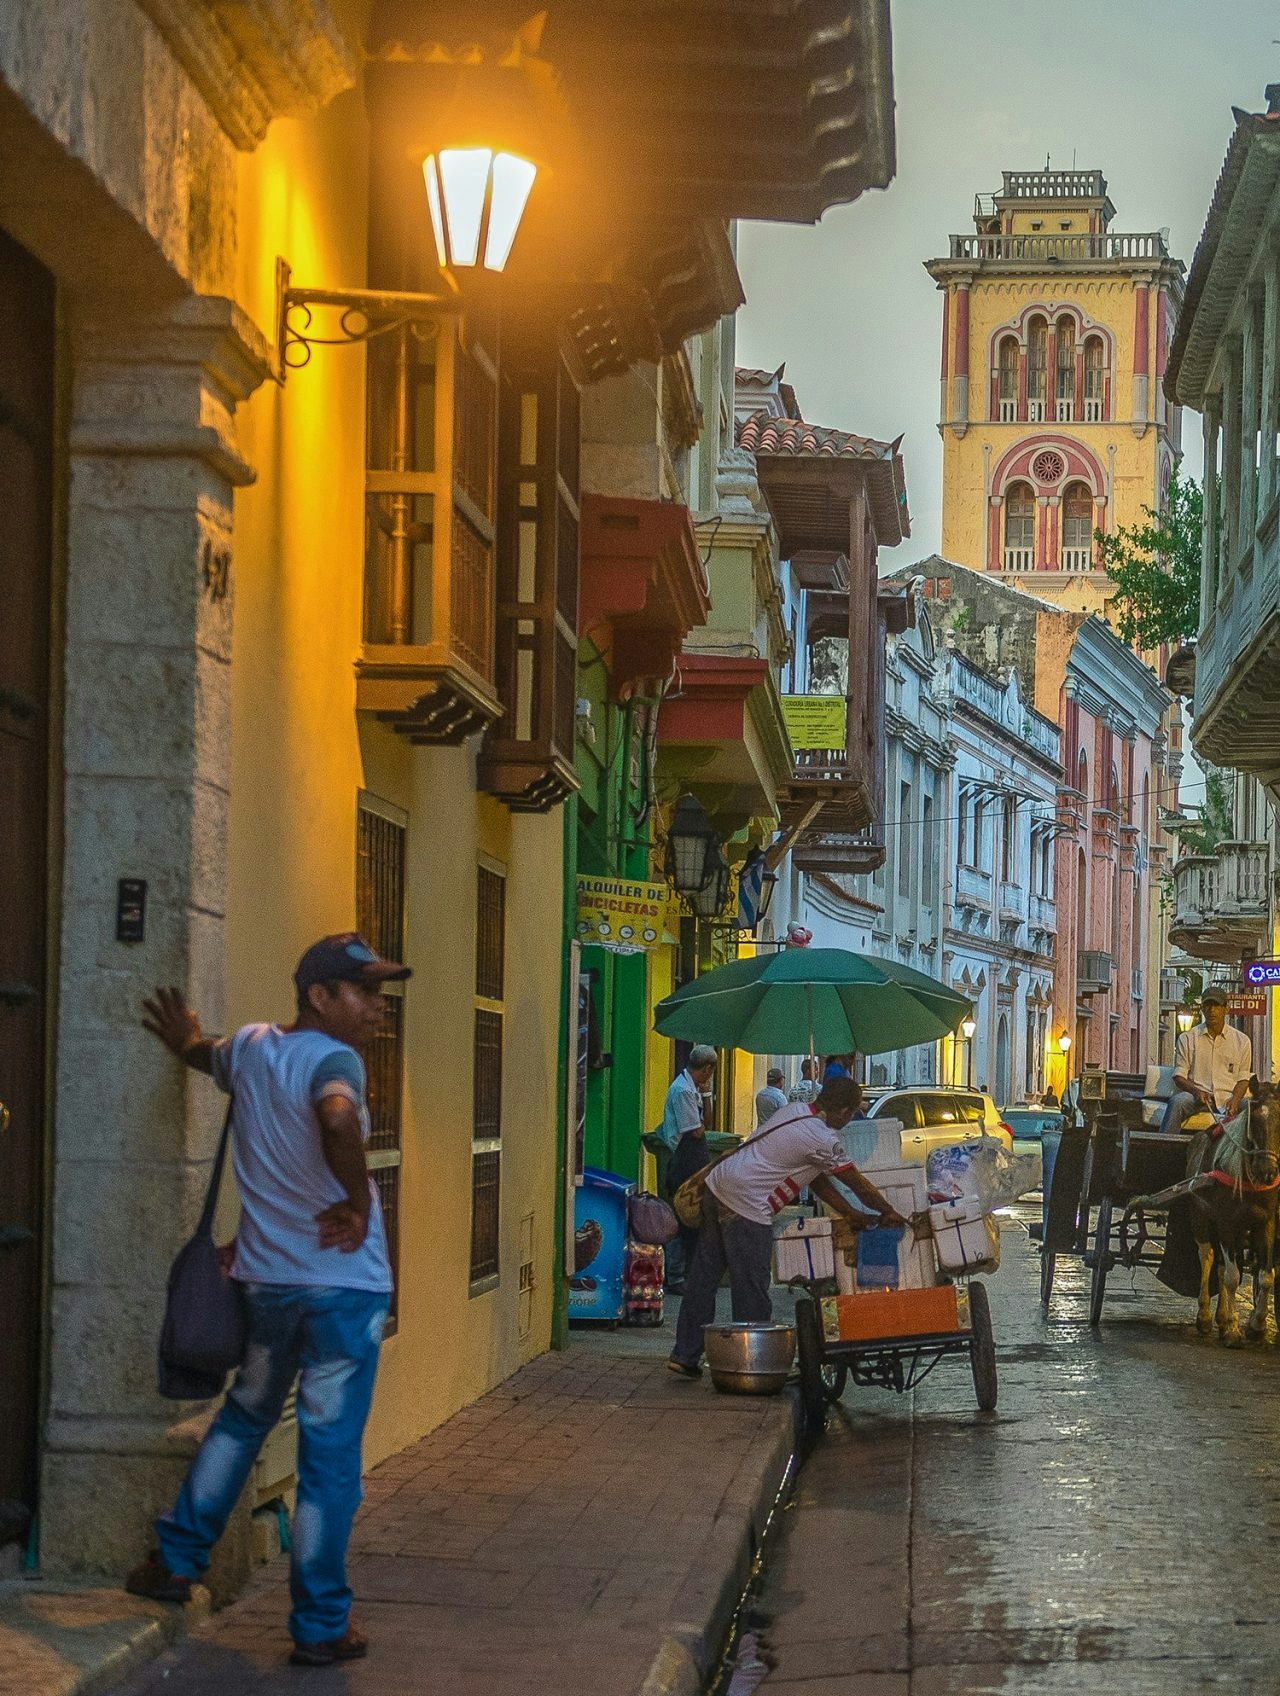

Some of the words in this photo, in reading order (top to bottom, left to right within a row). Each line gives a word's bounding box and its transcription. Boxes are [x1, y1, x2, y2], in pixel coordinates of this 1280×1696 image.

[579, 880, 642, 898] ALQUILER
[647, 888, 664, 901] DE
[1247, 1000, 1259, 1010] DI
